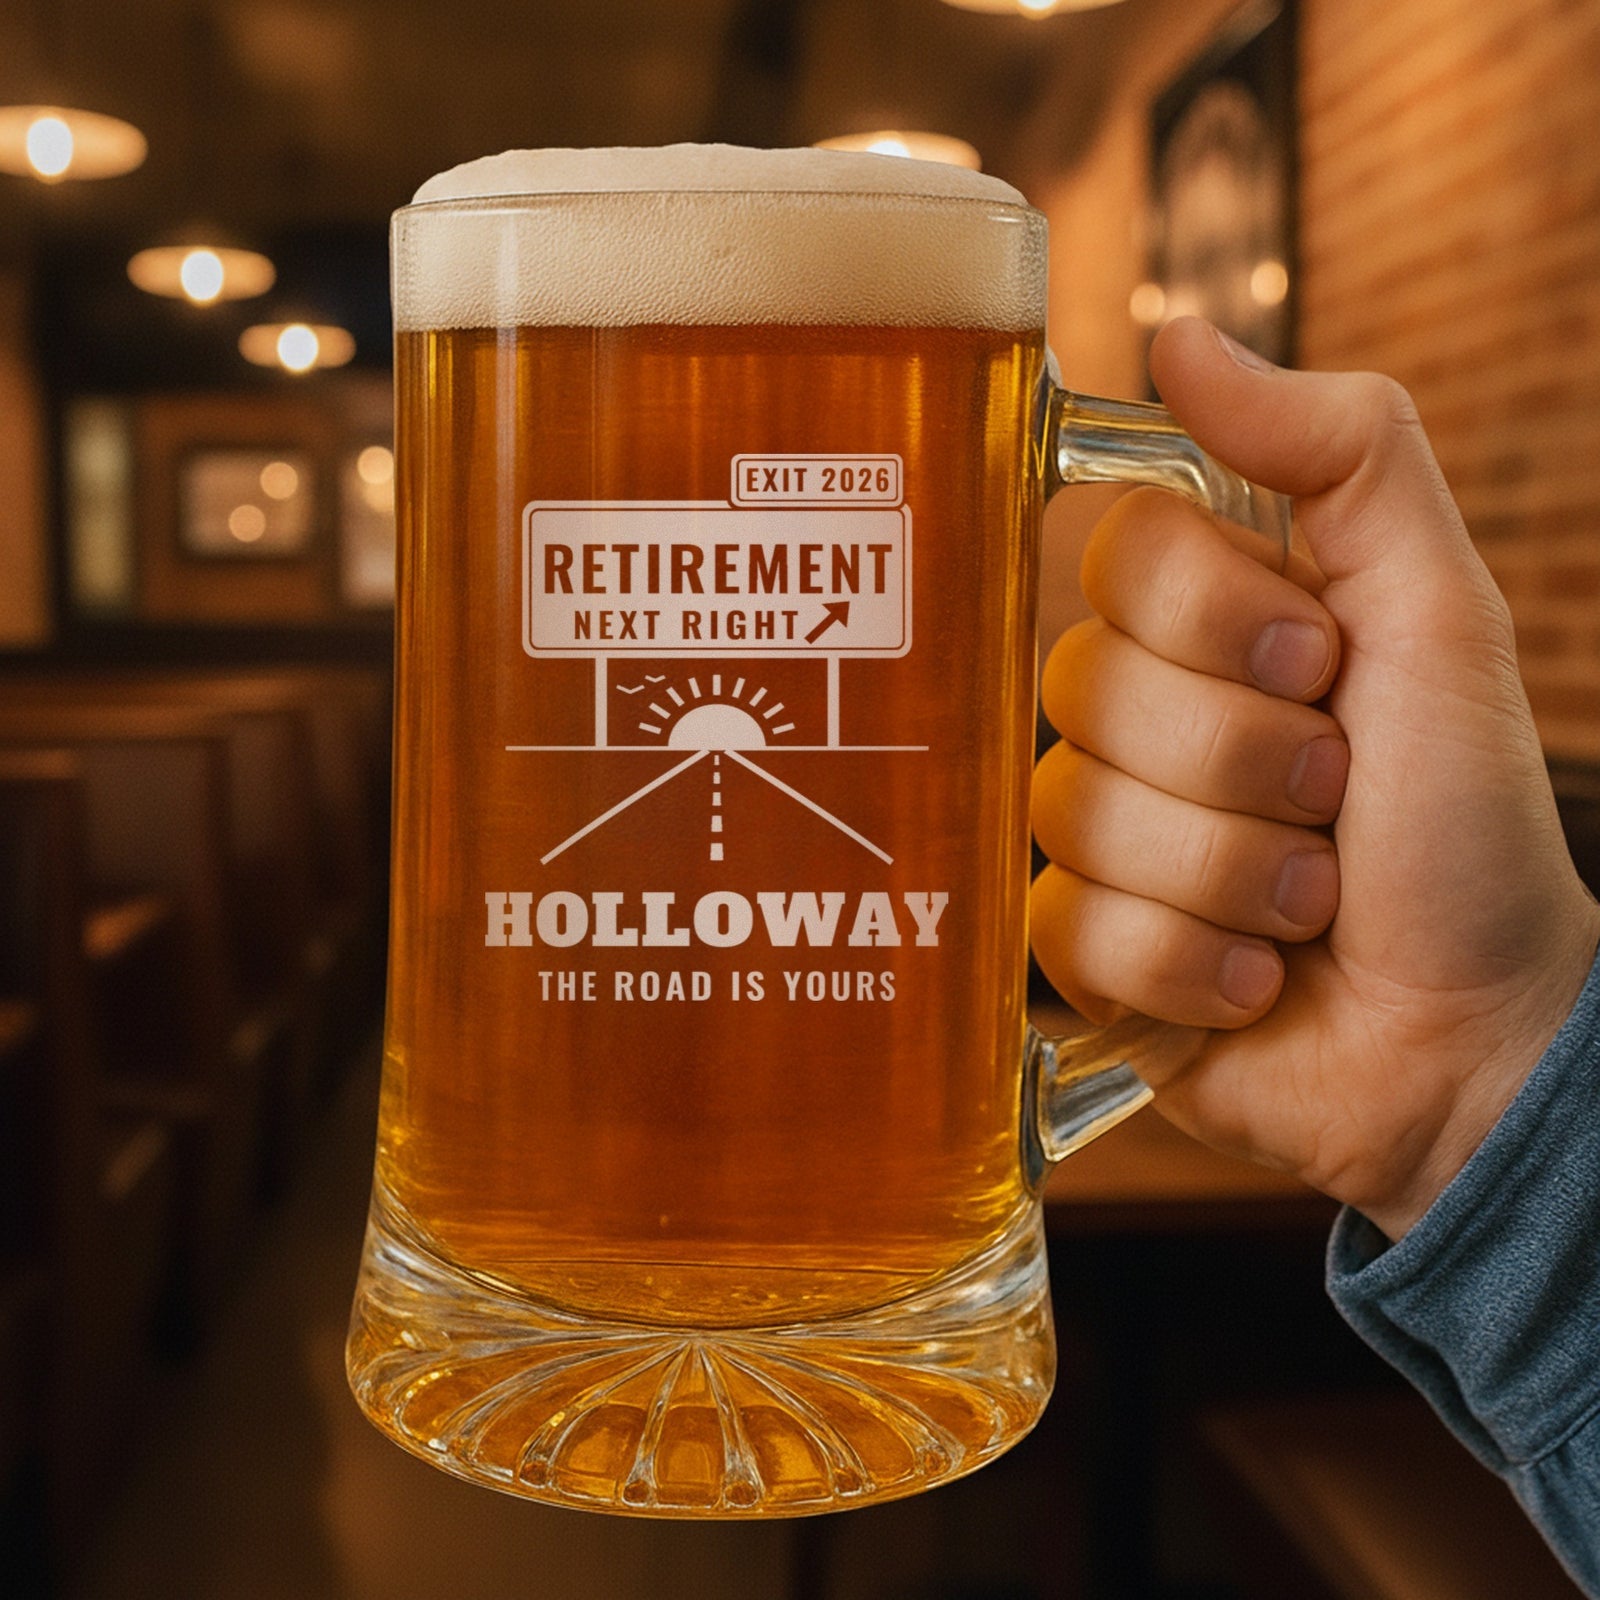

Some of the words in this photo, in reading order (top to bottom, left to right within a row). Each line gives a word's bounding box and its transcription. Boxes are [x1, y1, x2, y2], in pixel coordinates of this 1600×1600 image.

[746, 467, 808, 493] EXIT
[821, 467, 890, 493] 2026
[543, 543, 893, 594] RETIREMENT
[573, 610, 661, 640] NEXT
[681, 610, 799, 640] RIGHT
[484, 890, 949, 948] HOLLOWAY
[538, 971, 597, 1001] THE
[614, 971, 712, 1001] ROAD
[731, 971, 765, 1001] IS
[783, 971, 896, 1001] YOURS
